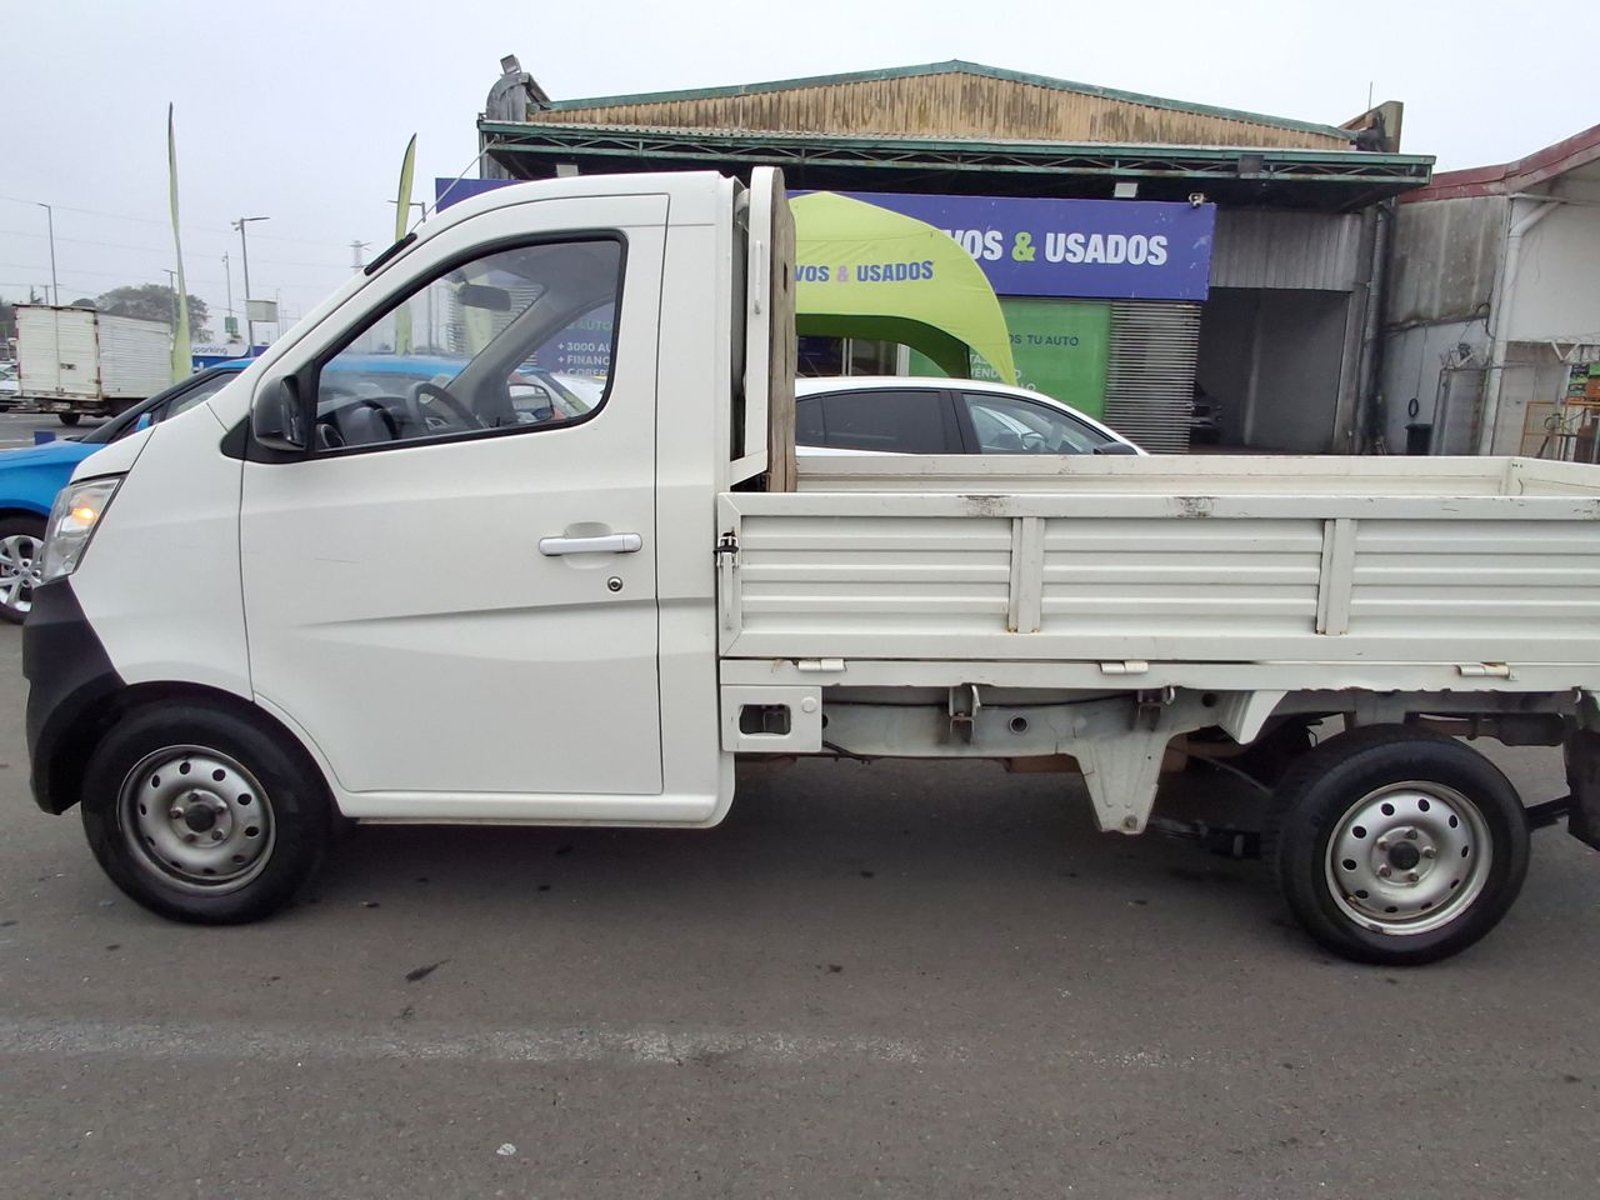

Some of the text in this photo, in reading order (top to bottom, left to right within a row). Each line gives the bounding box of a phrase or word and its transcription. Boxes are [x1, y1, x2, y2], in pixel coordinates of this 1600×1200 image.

[1012, 231, 1036, 262] &
[1045, 232, 1168, 266] USADOS
[837, 265, 849, 282] &
[857, 260, 935, 281] USADOS
[566, 342, 596, 352] 3000
[1027, 334, 1042, 346] TU
[1044, 336, 1080, 347] AUTO
